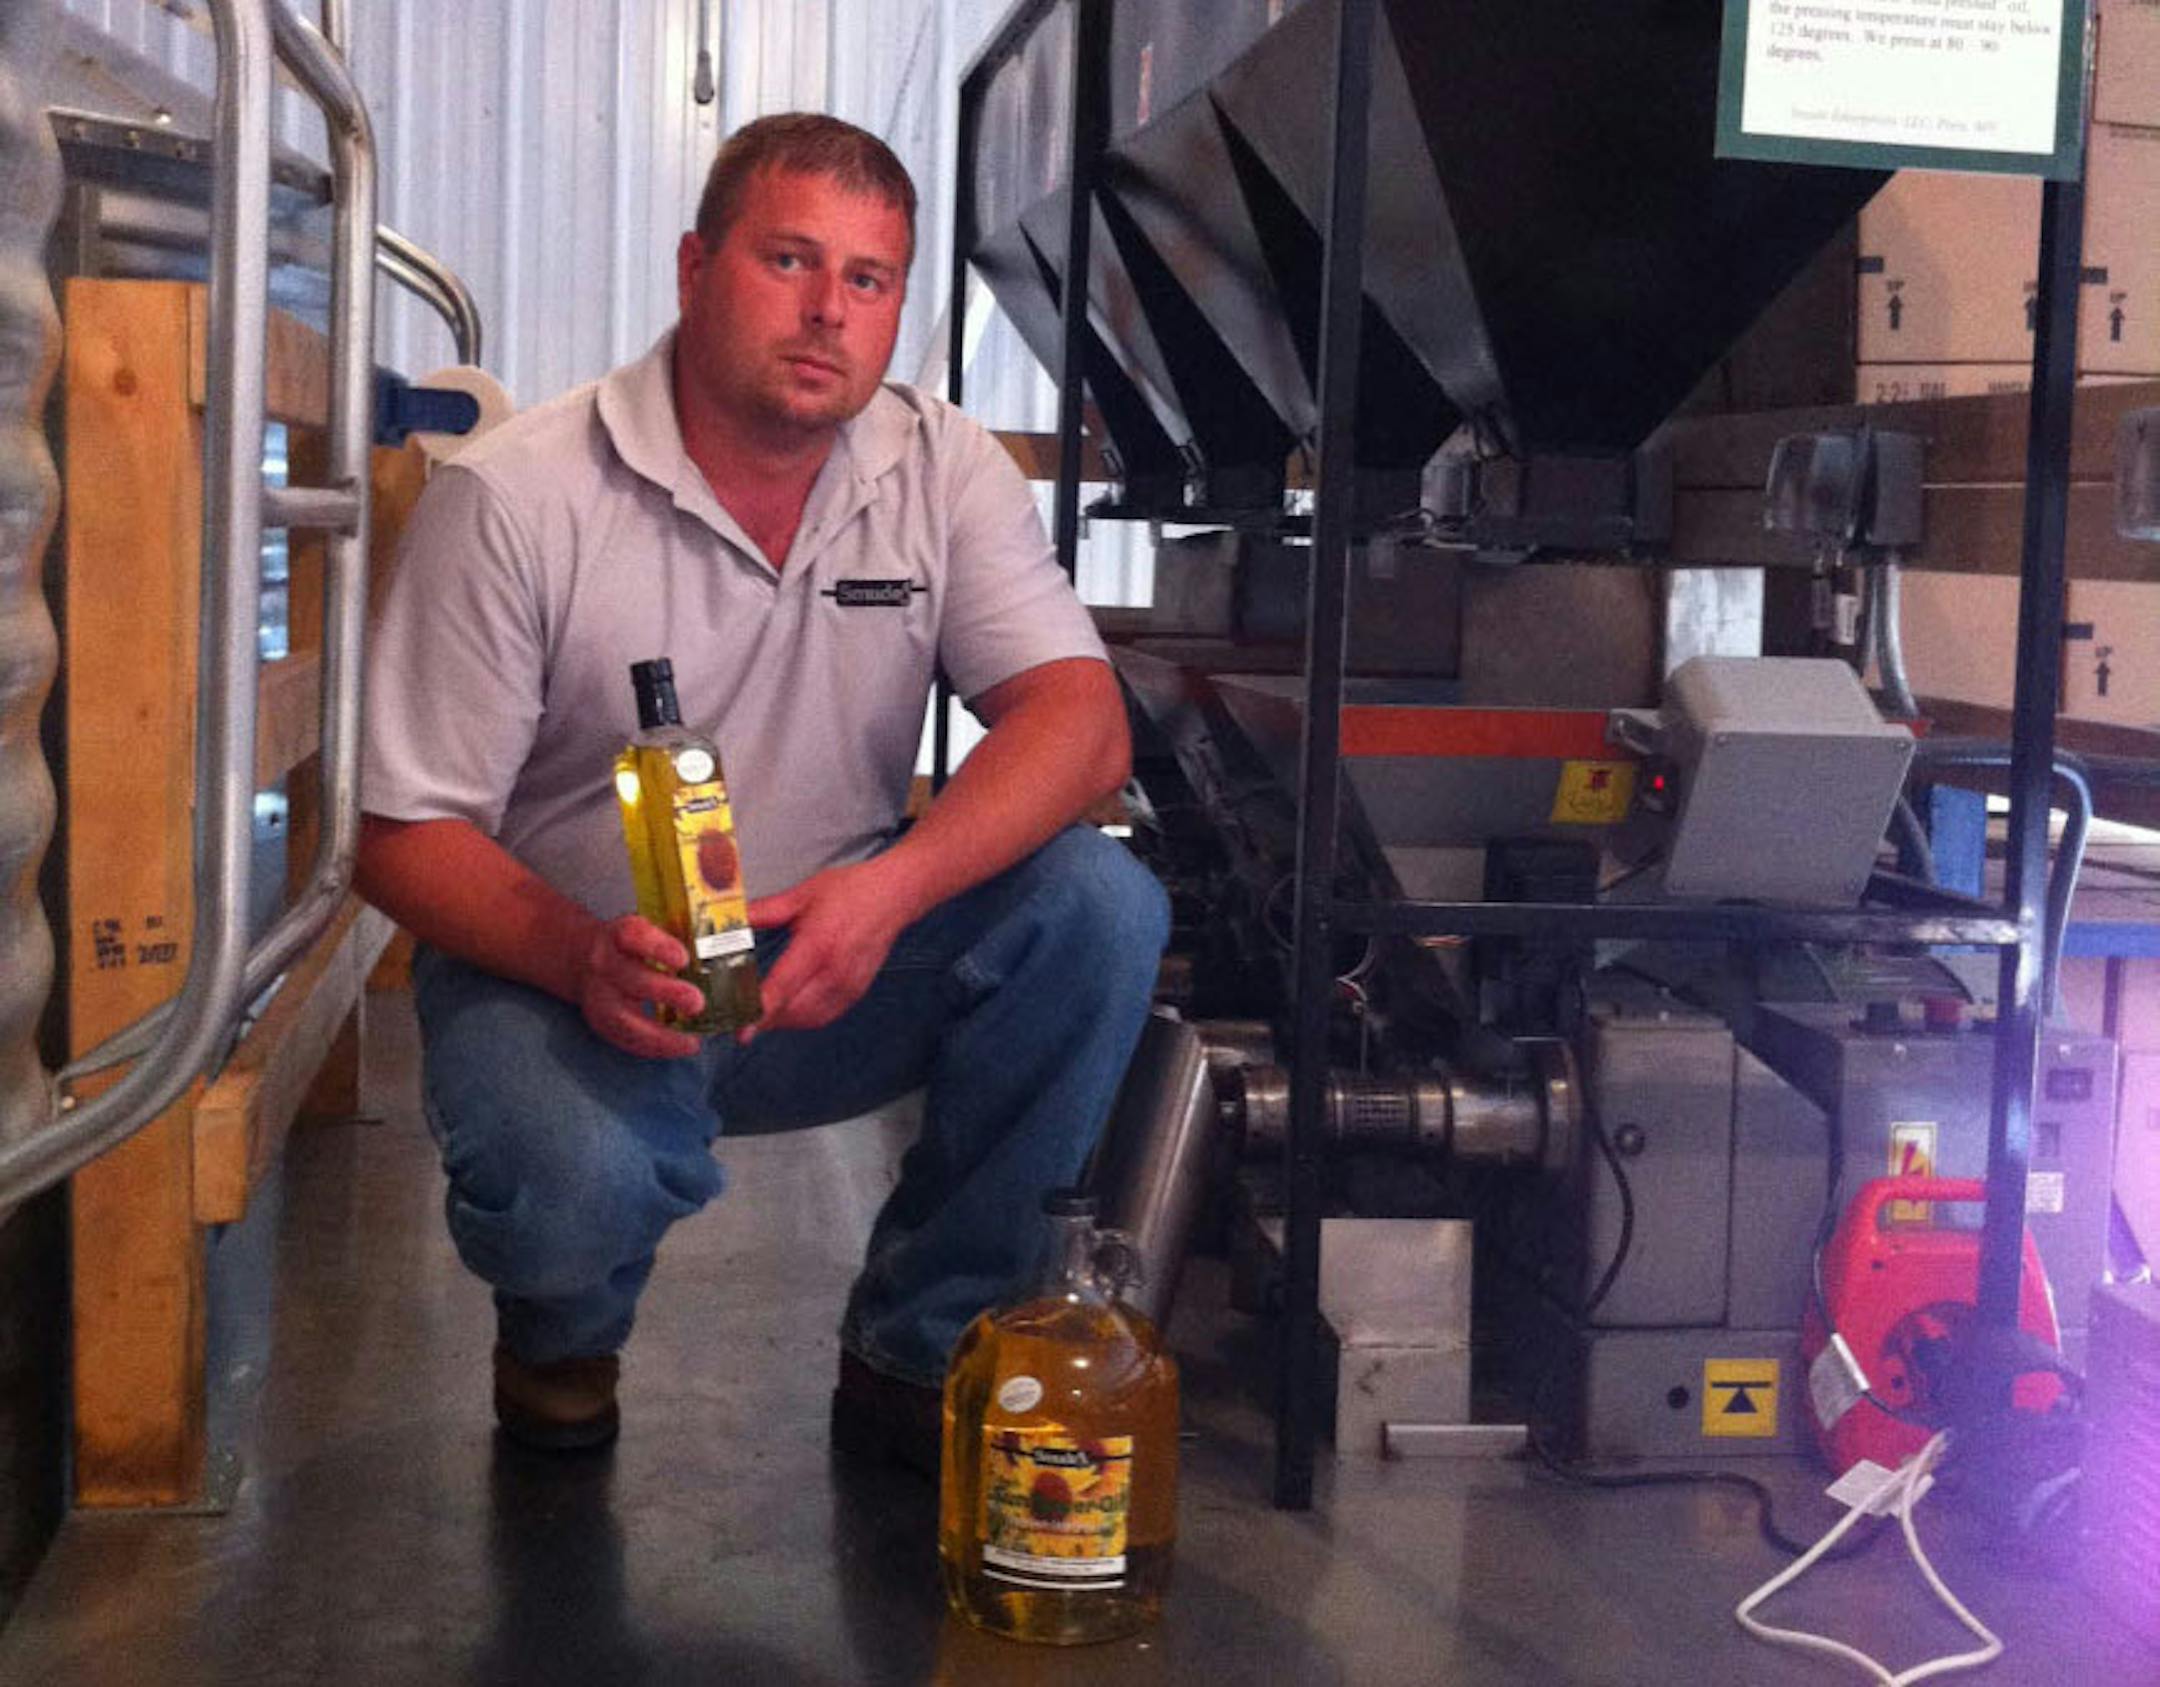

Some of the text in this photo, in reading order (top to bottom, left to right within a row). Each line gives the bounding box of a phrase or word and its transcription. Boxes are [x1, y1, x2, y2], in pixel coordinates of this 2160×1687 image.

[1769, 3, 2050, 34] the pressing temperature must stay below
[1770, 22, 1794, 36] 125
[1864, 30, 1887, 44] We
[1890, 36, 1925, 49] press
